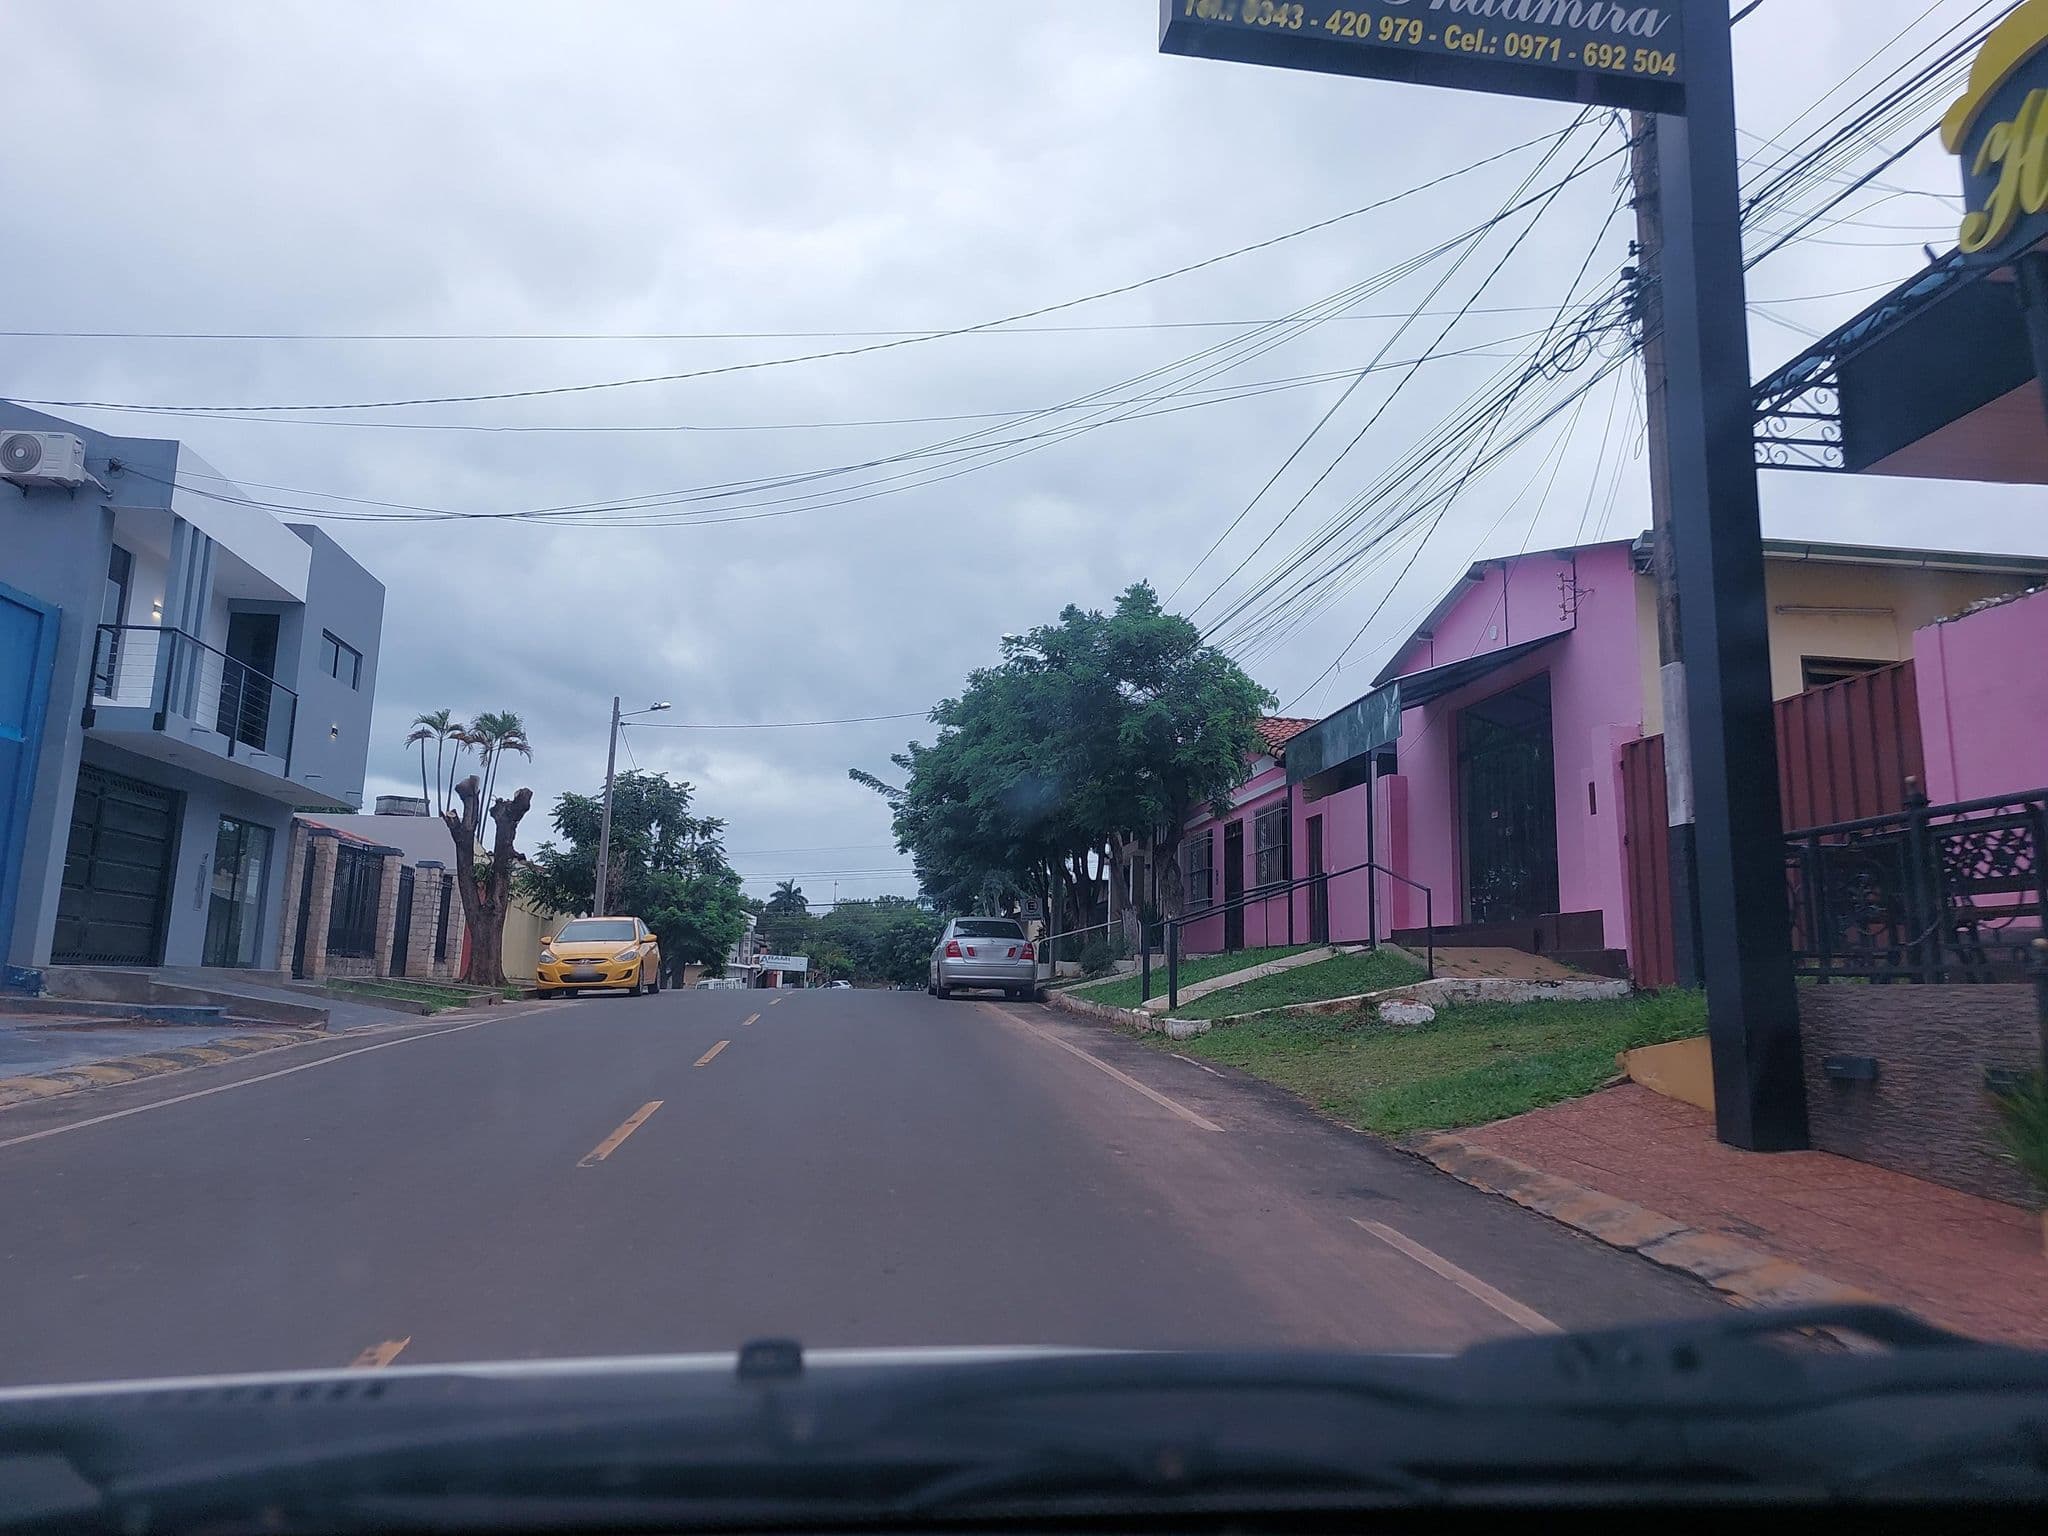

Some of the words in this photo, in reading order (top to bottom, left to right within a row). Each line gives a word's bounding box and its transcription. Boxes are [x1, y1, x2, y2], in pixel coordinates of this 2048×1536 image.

[1242, 0, 1304, 30] 0343
[1325, 9, 1373, 39] 420
[1378, 15, 1424, 45] 979
[1444, 24, 1498, 55] Cel.:
[1504, 32, 1562, 62] 0971
[1583, 42, 1626, 71] 692
[1633, 48, 1676, 77] 504
